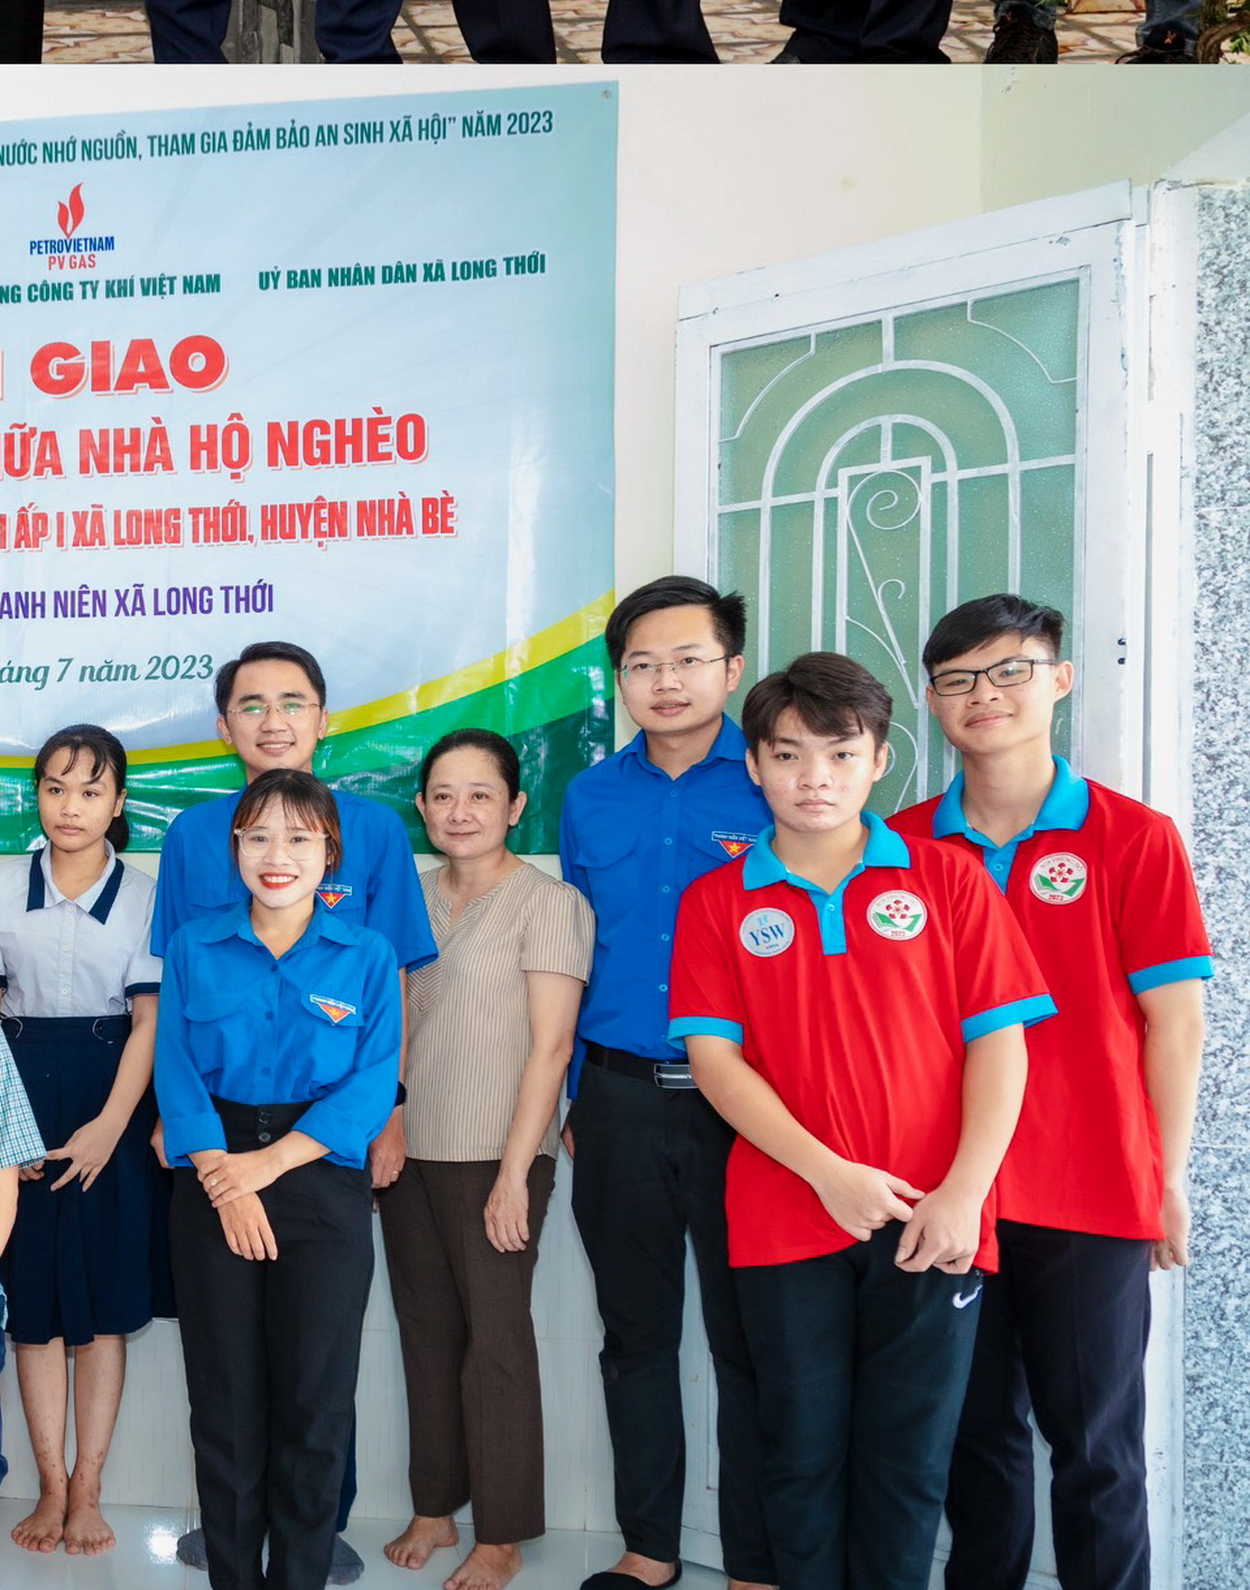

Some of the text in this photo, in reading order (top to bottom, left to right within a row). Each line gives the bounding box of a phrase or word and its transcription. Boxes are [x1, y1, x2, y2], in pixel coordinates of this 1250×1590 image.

[42, 135, 77, 163] NHỚ
[81, 130, 142, 162] NGUỒN,
[147, 132, 196, 157] THAM
[200, 129, 228, 154] GIA
[232, 121, 271, 152] ĐẢM
[275, 119, 310, 150] BẢO
[315, 124, 339, 147] AN
[343, 121, 384, 146] SINH
[389, 115, 413, 143] XÃ
[461, 110, 502, 138] NĂM
[507, 110, 553, 136] 2023
[30, 236, 115, 256] PETROVIETNAM
[48, 253, 96, 270] PV GAS
[27, 279, 74, 303] CÔNG
[79, 280, 100, 300] TY
[105, 275, 135, 299] KHÍ
[140, 272, 177, 300] VIỆT
[182, 273, 221, 294] NAM
[258, 250, 547, 291] UỶ BAN NHÂN DÂN XÃ LONG THỚI
[30, 334, 230, 396] GIAO
[79, 416, 175, 477] NHÀ
[189, 412, 253, 482] HỘ
[266, 406, 429, 470] NGHÈO
[14, 502, 51, 550] ẤP
[72, 504, 107, 550] XÃ
[113, 508, 183, 550] LONG
[261, 495, 350, 551] HUYỆN
[356, 491, 416, 539] NHÀ
[422, 489, 458, 537] BÈ
[52, 585, 108, 619] NIÊN
[114, 584, 148, 618] XÃ
[153, 586, 214, 616] LONG
[219, 579, 275, 614] THỚI
[56, 658, 73, 683] 7
[78, 658, 141, 683] năm
[147, 654, 215, 683] 2023
[750, 923, 785, 947] YSW
